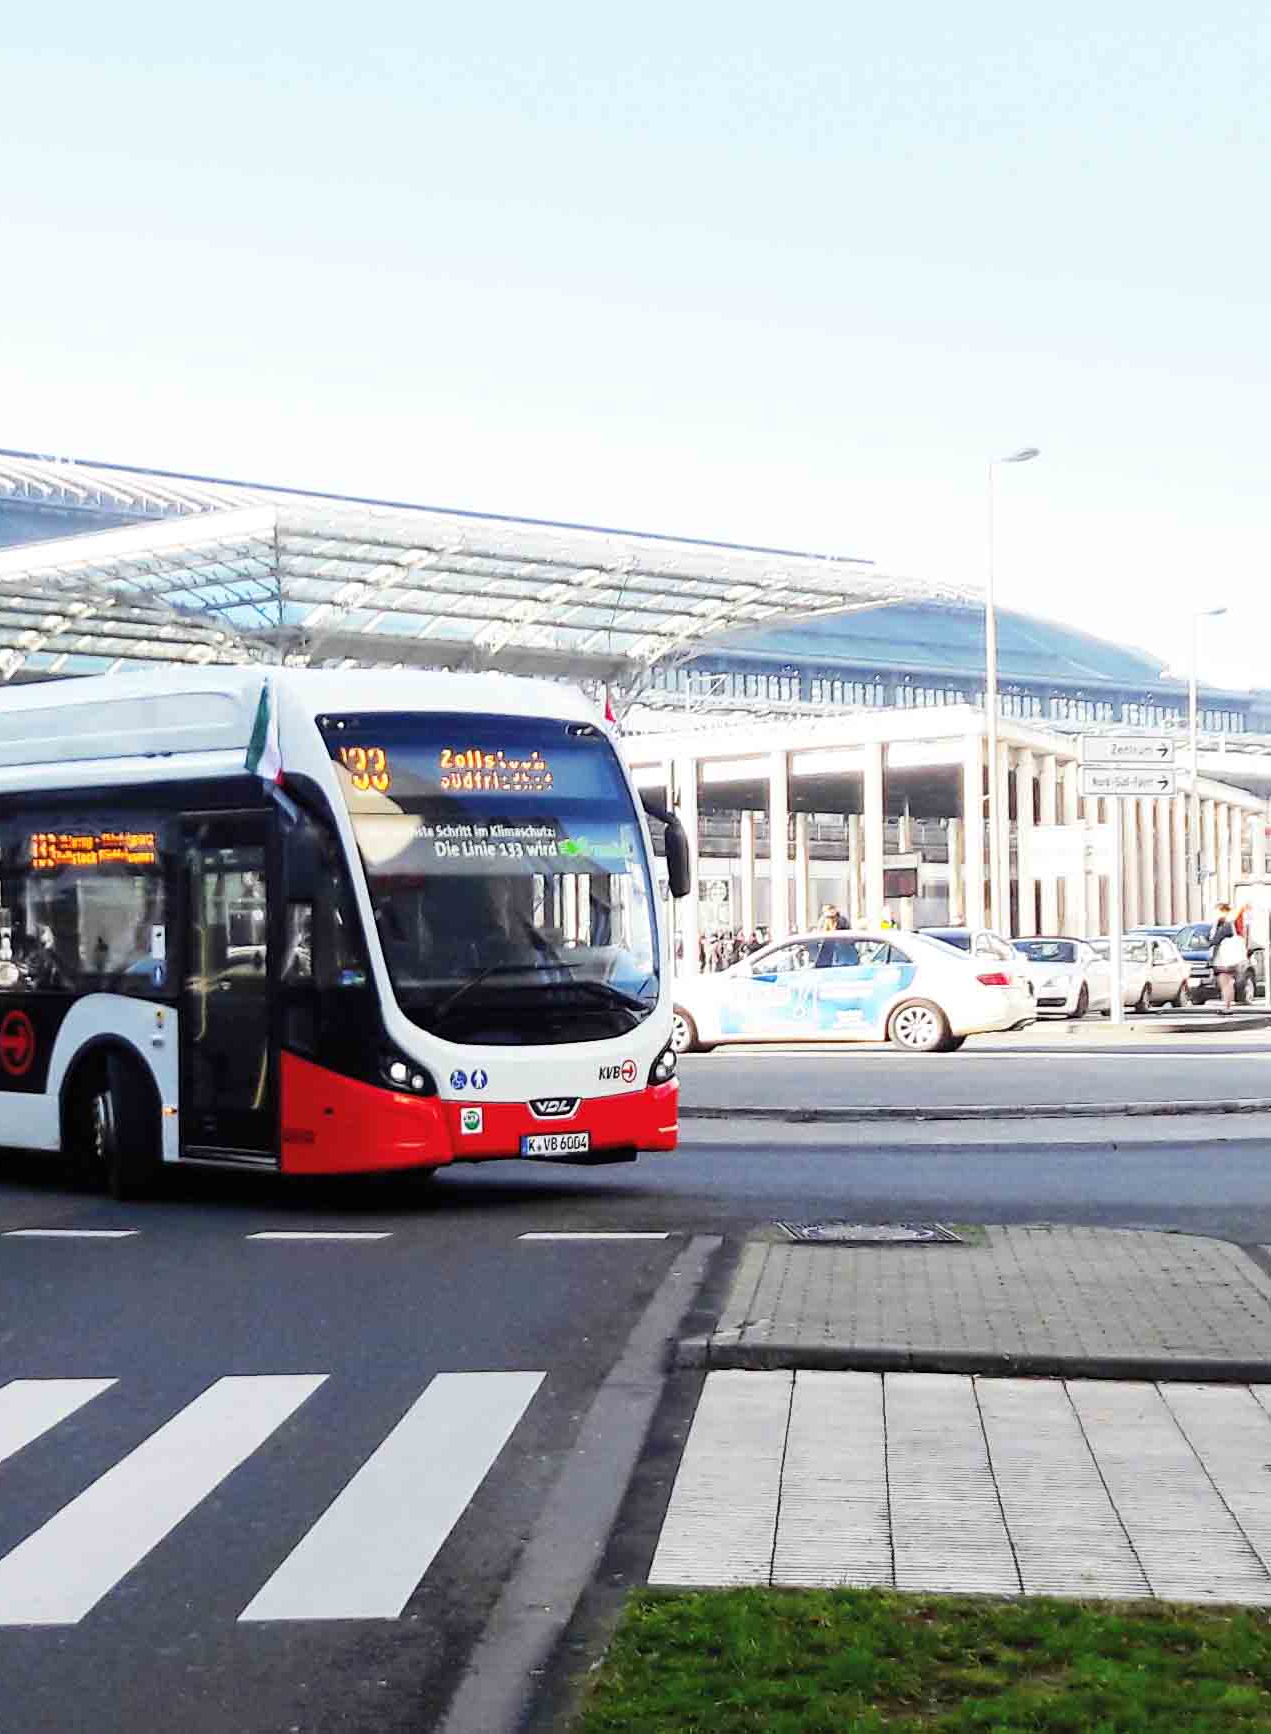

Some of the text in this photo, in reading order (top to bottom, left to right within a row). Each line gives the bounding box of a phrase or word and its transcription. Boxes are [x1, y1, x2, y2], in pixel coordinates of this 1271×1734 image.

[435, 825, 472, 838] Schritt
[473, 825, 489, 838] im
[434, 840, 460, 857] Die
[461, 840, 497, 857] Linie
[500, 843, 524, 859] 133
[526, 840, 557, 857] wird
[598, 1065, 621, 1081] KVB
[535, 1101, 571, 1112] VDL
[528, 1134, 587, 1152] K VB 6004
